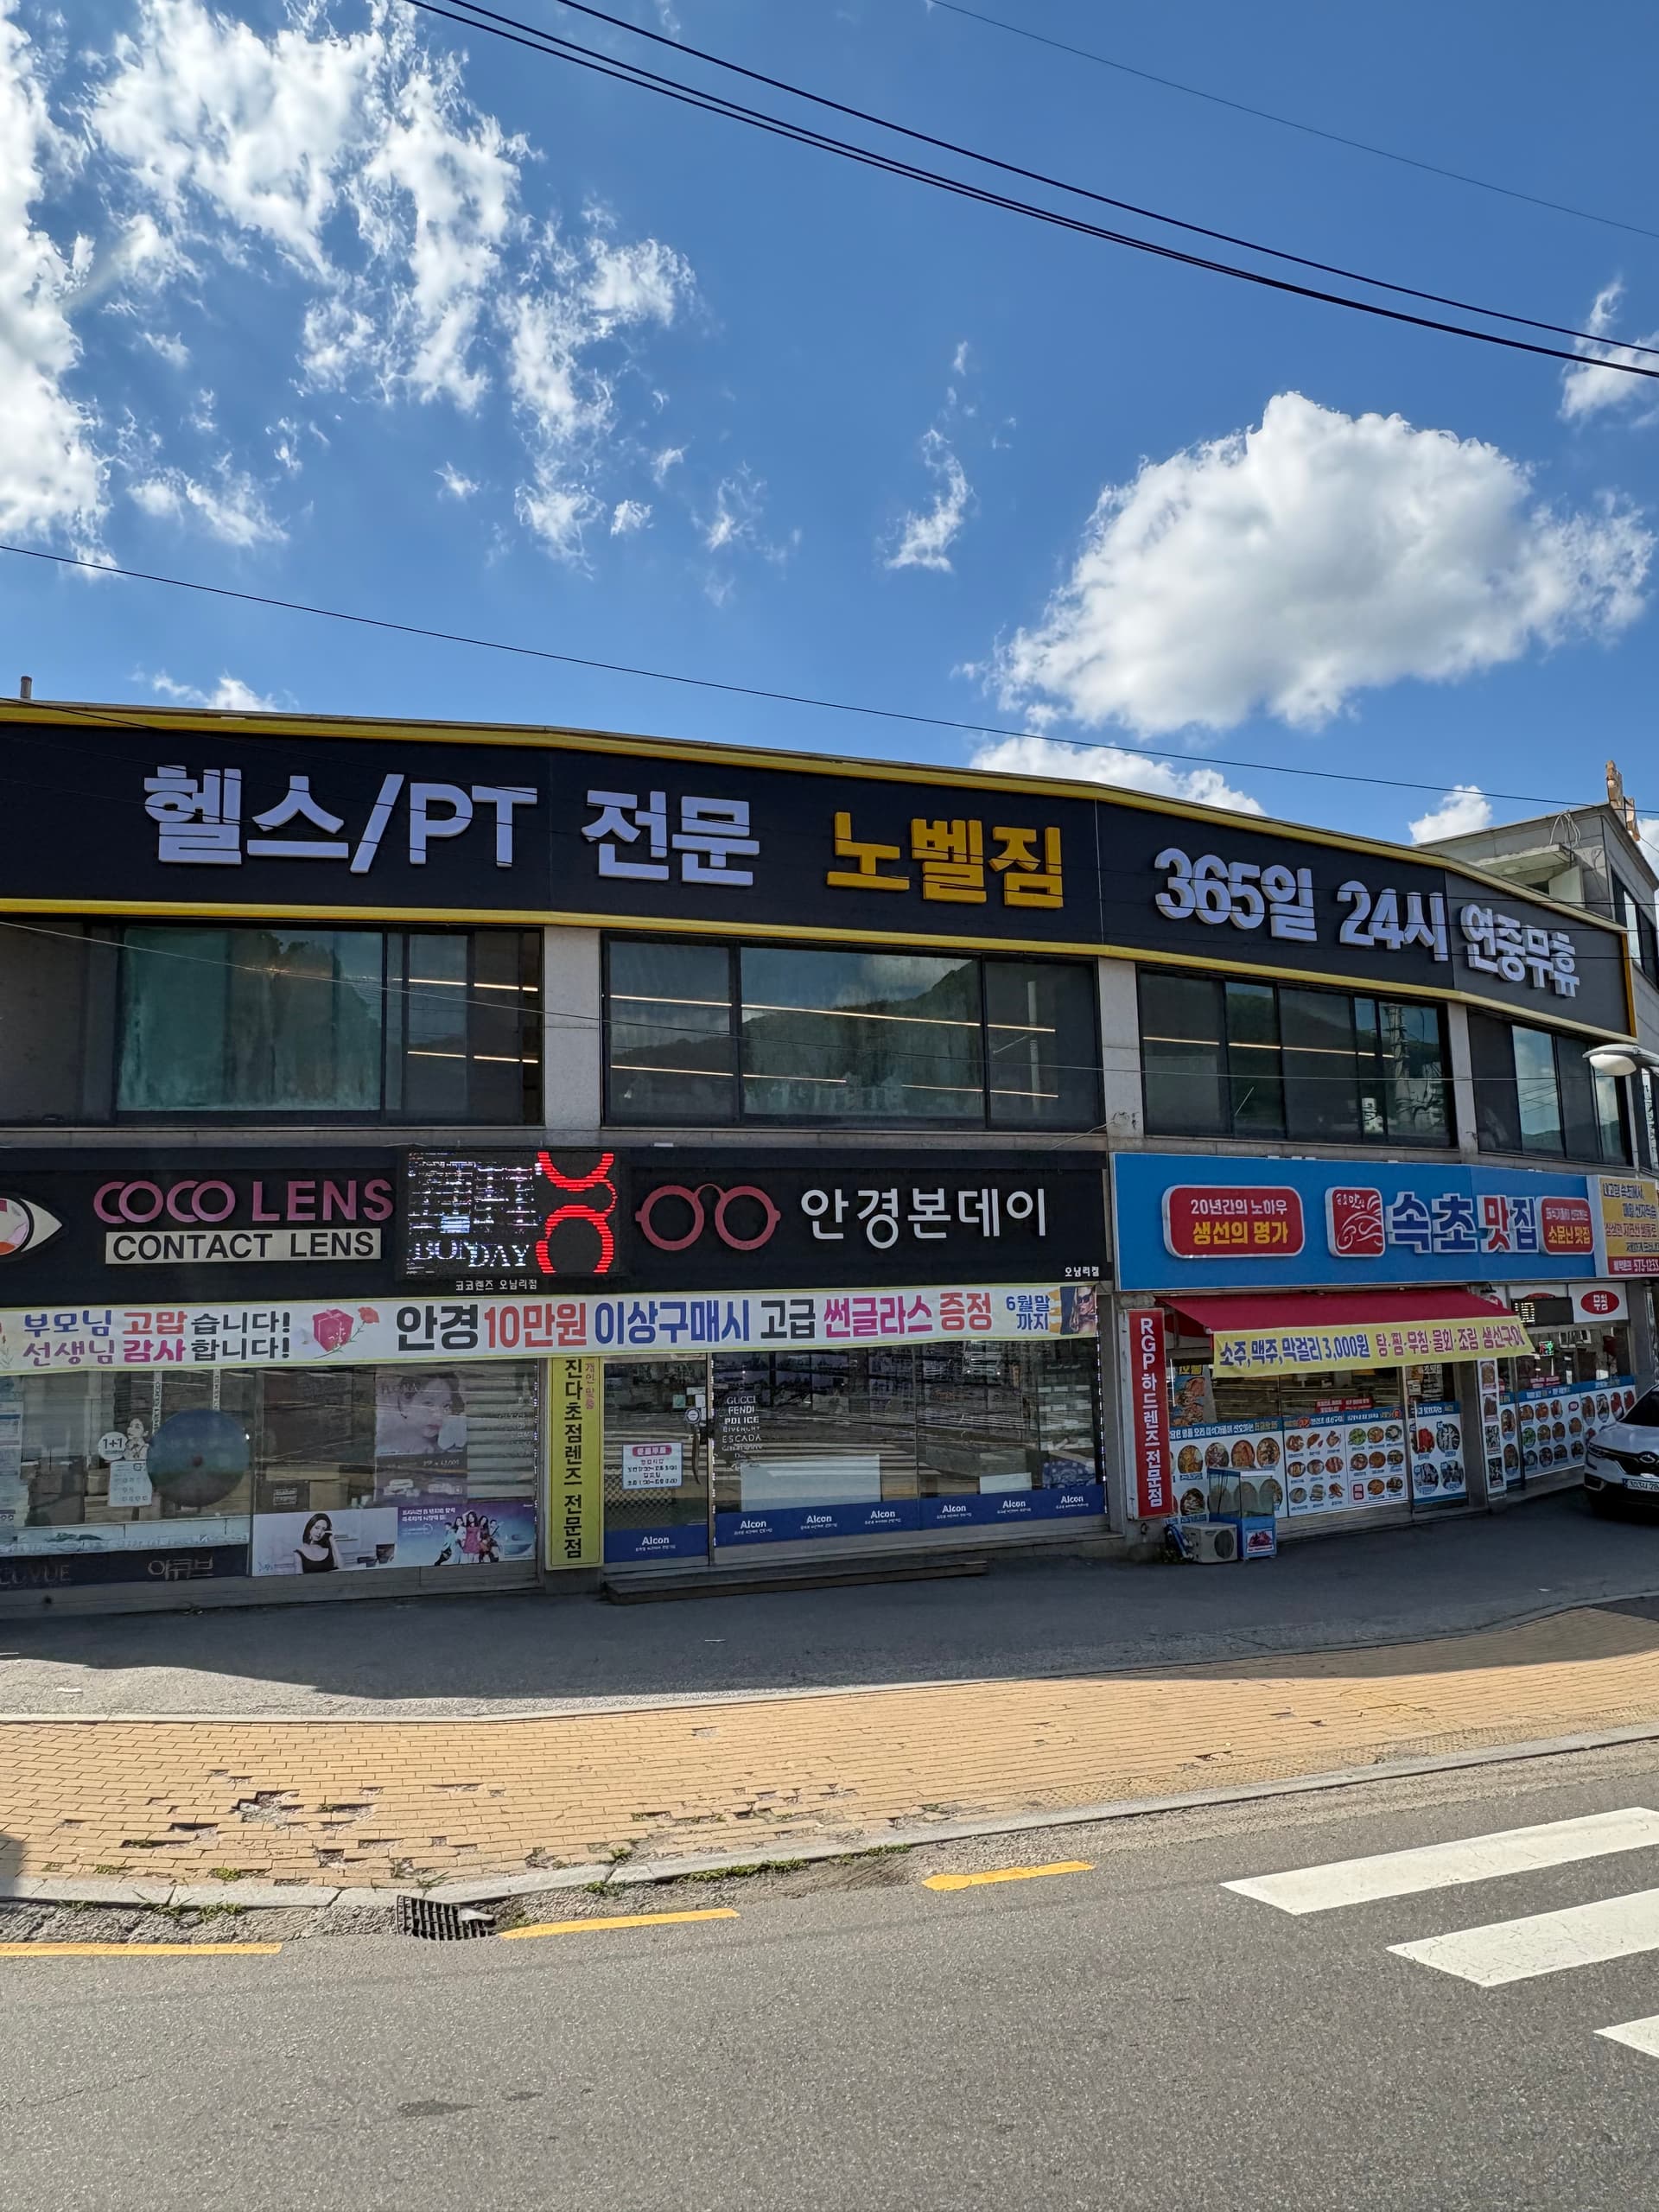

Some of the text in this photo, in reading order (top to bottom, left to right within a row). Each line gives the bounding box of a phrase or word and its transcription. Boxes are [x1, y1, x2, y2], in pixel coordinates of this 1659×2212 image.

[143, 765, 1580, 997] 헬스/PT 전문 노벨짐 365일 24시 연중무휴
[93, 1180, 236, 1224] COCO
[252, 1178, 395, 1223] LENS
[1191, 1199, 1287, 1215] 20년간의 노하우
[801, 1188, 1046, 1249] 안경본데이
[1192, 1221, 1288, 1245] 생선의 명가
[1548, 1226, 1590, 1244] 소문난 맛집
[113, 1232, 374, 1261] CONTACT LENS
[456, 1280, 494, 1291] 코코렌즈
[1006, 1295, 1050, 1313] 6월말
[24, 1310, 290, 1338] 부모님 고맙습니다!
[396, 1305, 479, 1351] 안경
[484, 1302, 587, 1348] 10만원
[760, 1299, 817, 1339] 고급
[823, 1295, 933, 1338] 썬글라스
[939, 1292, 992, 1331] 증정
[1016, 1313, 1049, 1331] 까지
[22, 1338, 290, 1367] 선생님 감사합니다!
[1323, 1334, 1370, 1361] 3,000원
[727, 1395, 756, 1405] GUCCI
[728, 1406, 754, 1414] FENDI
[1140, 1318, 1162, 1508] RGP 하드렌즈 전문점
[103, 1438, 123, 1449] 1+1
[721, 1434, 762, 1443] ESCADA
[1002, 1500, 1026, 1509] Alcon
[806, 1515, 832, 1523] Alcon
[870, 1510, 896, 1519] Alcon
[563, 1495, 582, 1559] 전문점
[740, 1520, 766, 1529] Alcon
[641, 1535, 670, 1546] Alcon
